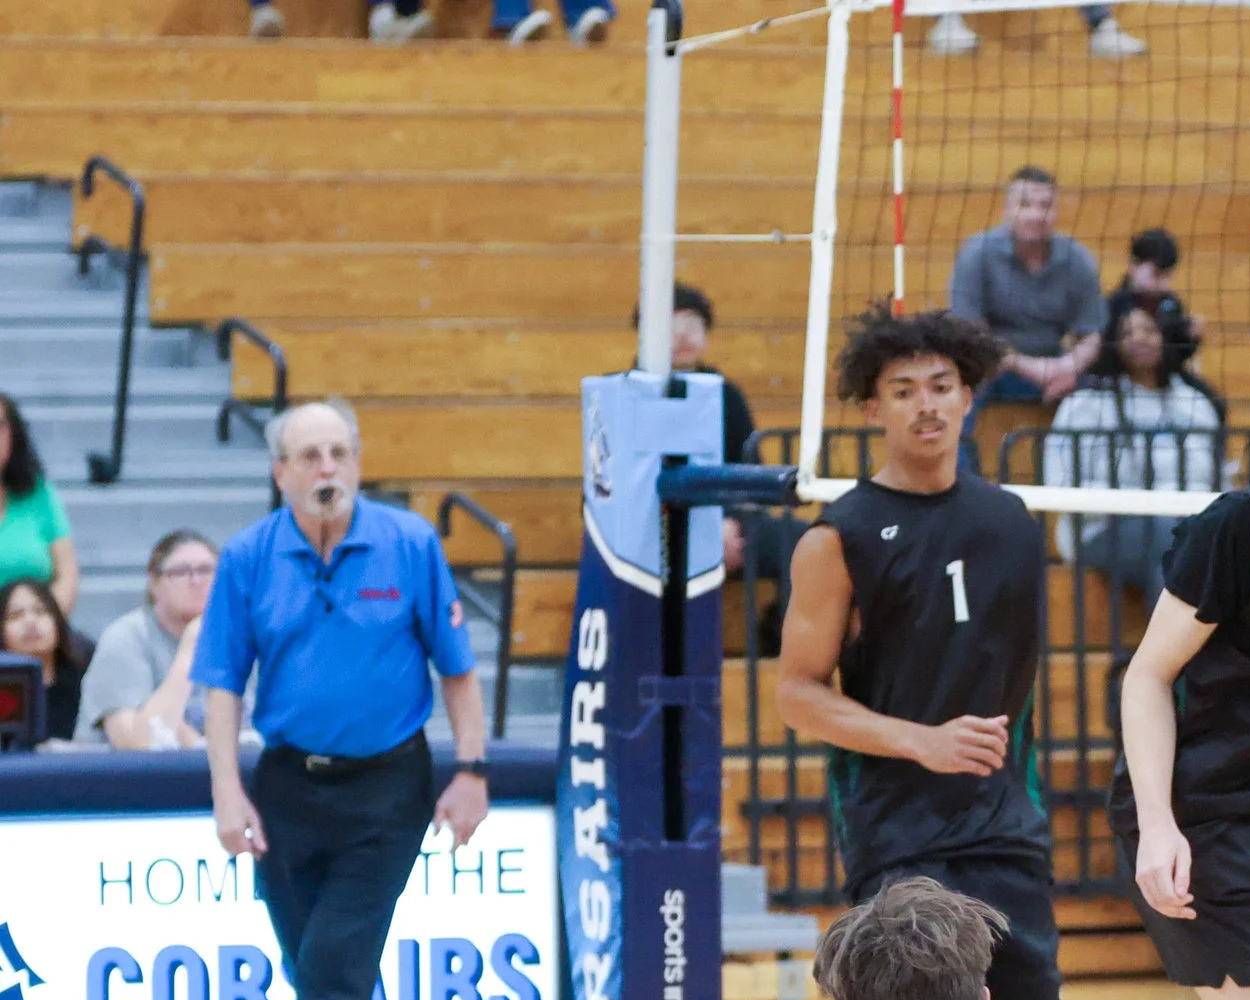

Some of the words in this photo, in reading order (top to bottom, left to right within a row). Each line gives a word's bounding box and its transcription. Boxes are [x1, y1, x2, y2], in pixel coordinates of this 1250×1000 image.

[946, 559, 970, 623] 1
[419, 848, 526, 895] THE
[659, 888, 687, 983] sports
